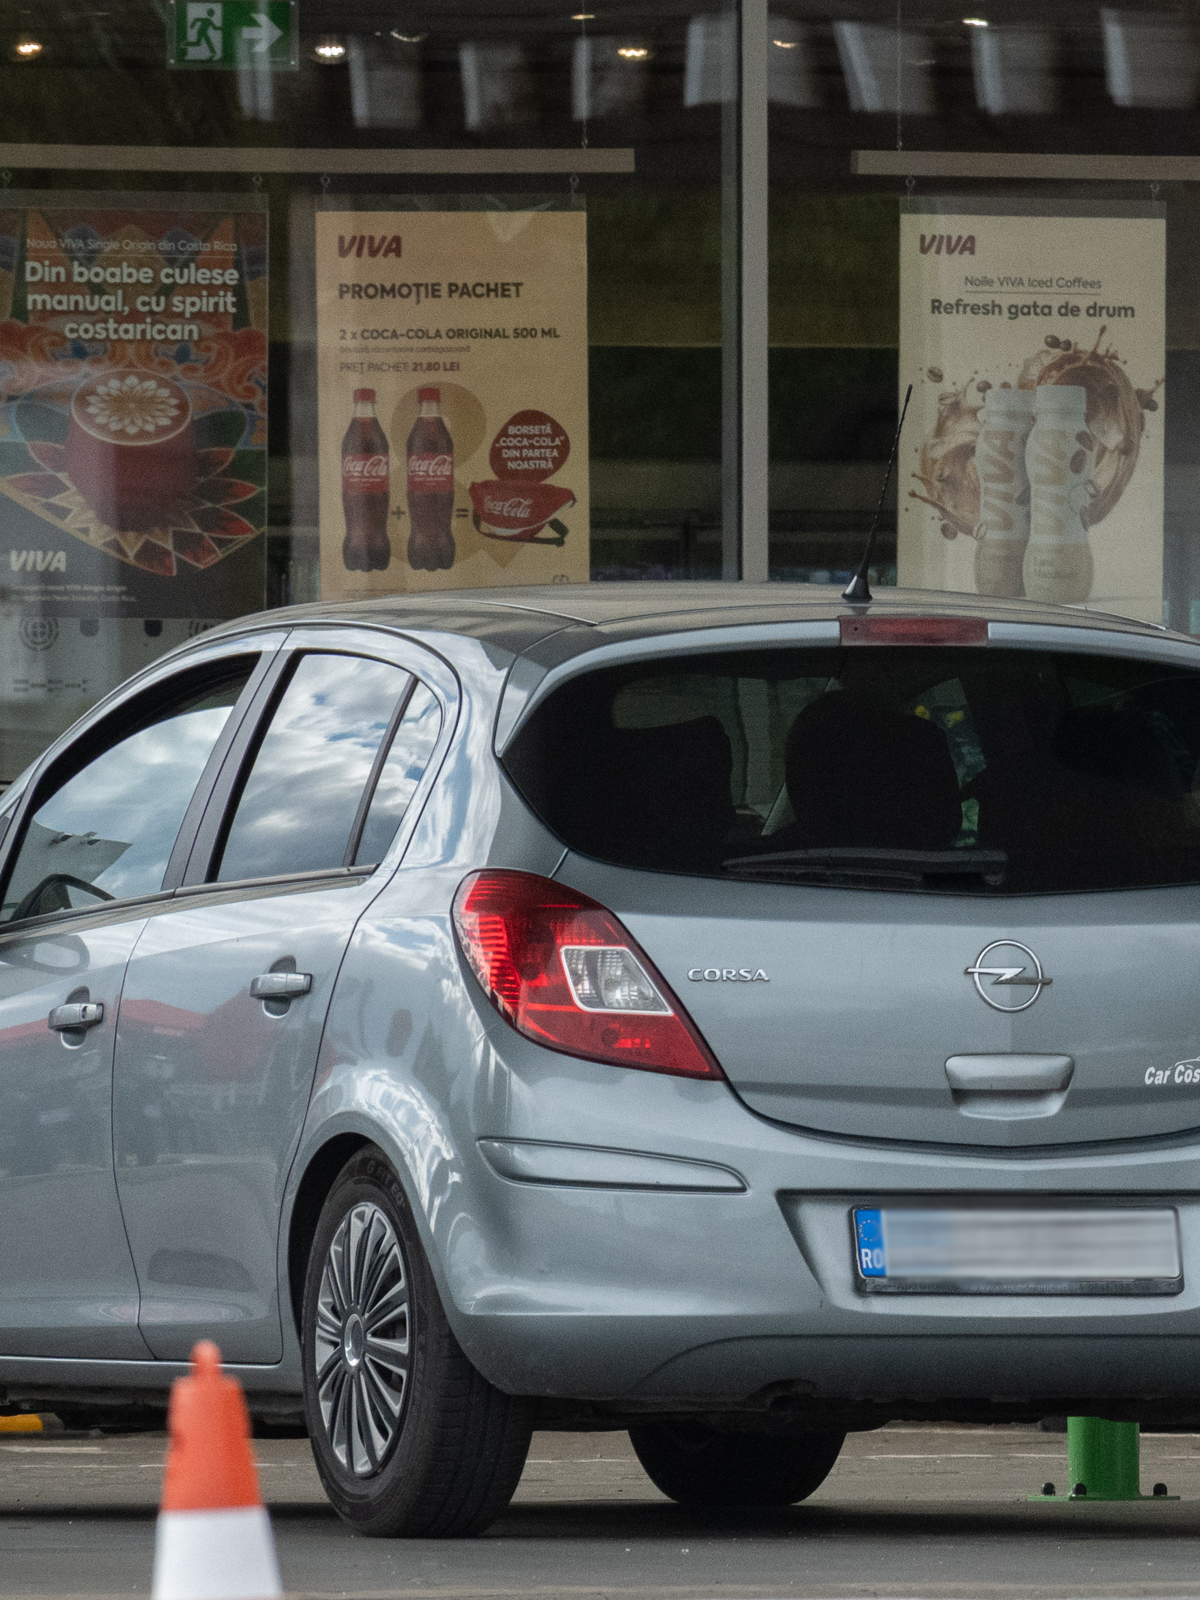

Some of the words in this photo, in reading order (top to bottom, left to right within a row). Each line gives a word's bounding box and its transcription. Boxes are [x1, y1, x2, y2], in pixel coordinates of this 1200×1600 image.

[60, 239, 85, 250] VIVA
[87, 239, 120, 253] Single
[122, 239, 156, 253] Origin
[158, 239, 175, 251] din
[178, 240, 211, 252] Costa
[213, 240, 238, 252] Rica
[338, 234, 402, 259] VIVA
[919, 234, 976, 256] VIVA
[25, 260, 66, 283] Din
[72, 261, 153, 284] boabe
[160, 263, 239, 285] culese
[964, 275, 994, 288] Noile
[997, 276, 1024, 288] VIVA
[1028, 276, 1052, 289] Iced
[1056, 276, 1102, 289] Coffees
[447, 281, 524, 299] PACHET
[26, 290, 130, 315] manual,
[135, 295, 165, 312] cu
[172, 290, 237, 318] spirit
[930, 298, 1002, 316] Refresh
[1008, 301, 1051, 321] gata
[1057, 300, 1080, 317] de
[1086, 301, 1135, 319] drum
[64, 318, 199, 341] costarican
[339, 329, 347, 340] 2
[350, 331, 357, 340] x
[361, 328, 443, 341] COCA-COLA
[446, 327, 510, 340] ORIGINAL
[512, 327, 538, 339] 500
[541, 327, 561, 339] ML
[411, 361, 441, 373] 21,80
[443, 361, 460, 372] LEI
[502, 448, 521, 458] DIN
[522, 448, 559, 459] PARTEA
[9, 550, 67, 572] VIVA
[687, 968, 770, 982] CORSA
[1144, 1066, 1172, 1085] Car
